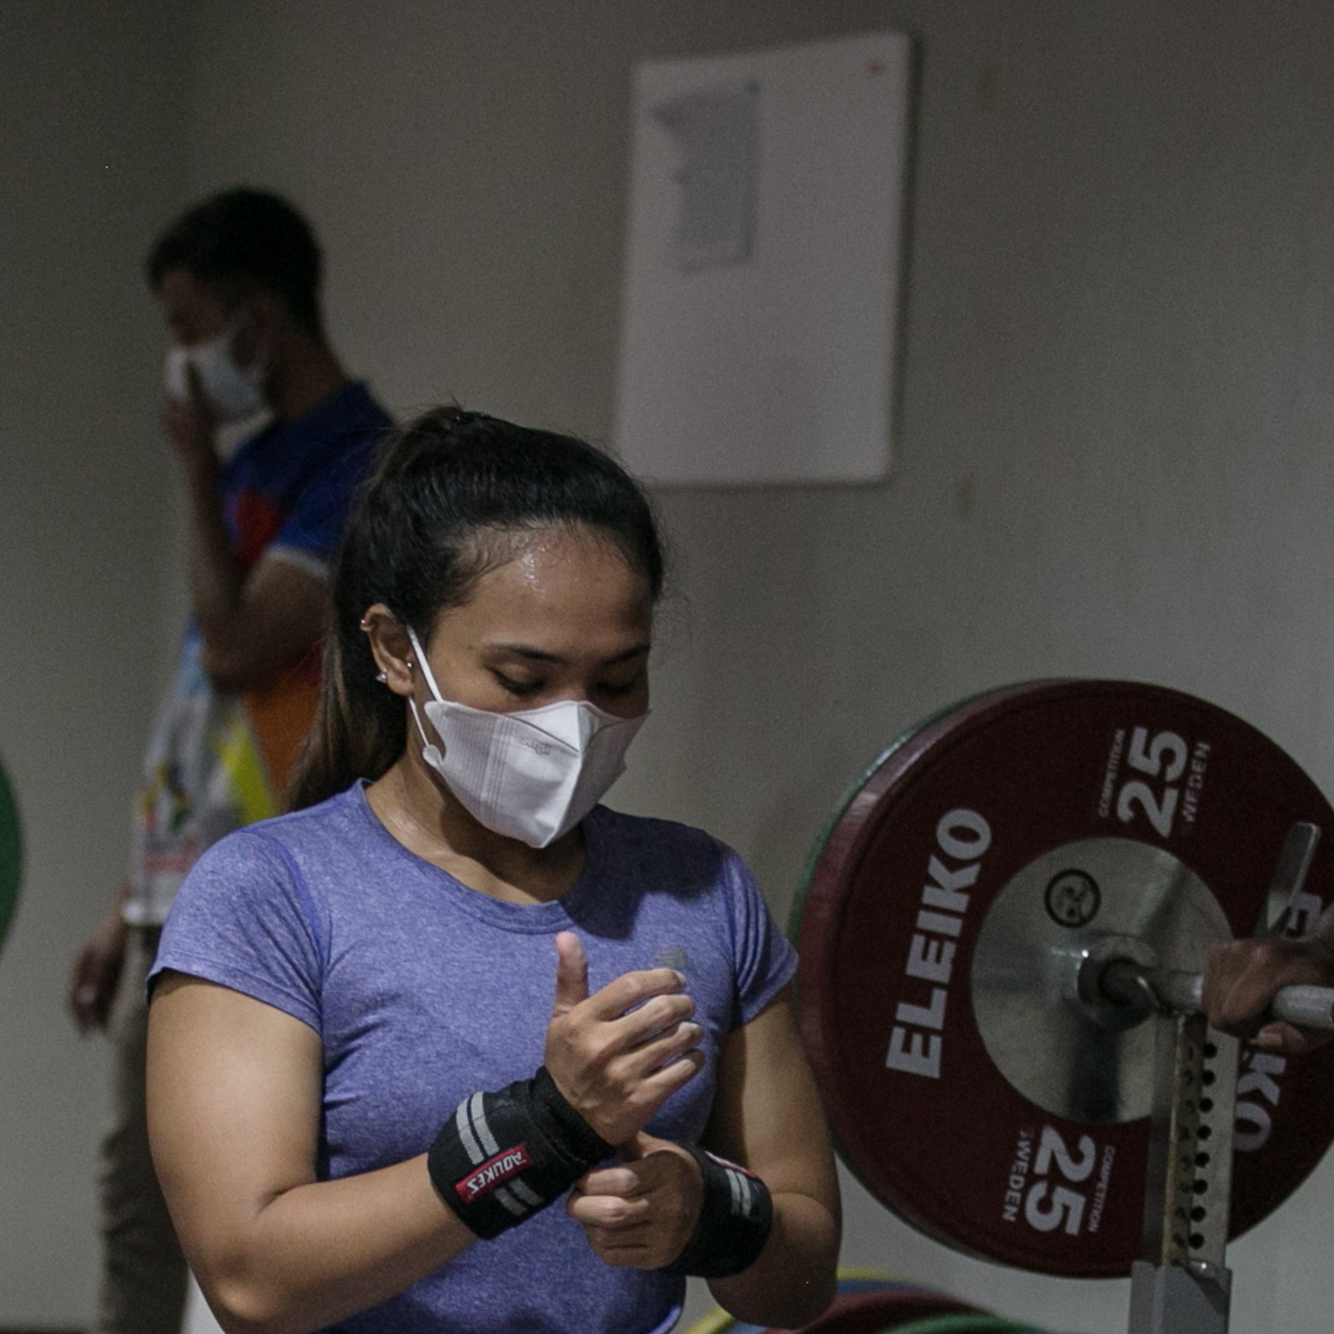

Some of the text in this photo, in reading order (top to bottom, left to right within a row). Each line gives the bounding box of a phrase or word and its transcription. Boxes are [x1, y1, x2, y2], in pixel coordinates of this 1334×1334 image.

[1116, 725, 1188, 839] 25
[1181, 741, 1211, 824] WEDEN
[884, 808, 992, 1079] ELEIKO
[1024, 1123, 1097, 1237] 25
[1087, 1144, 1116, 1233] COMPETITION
